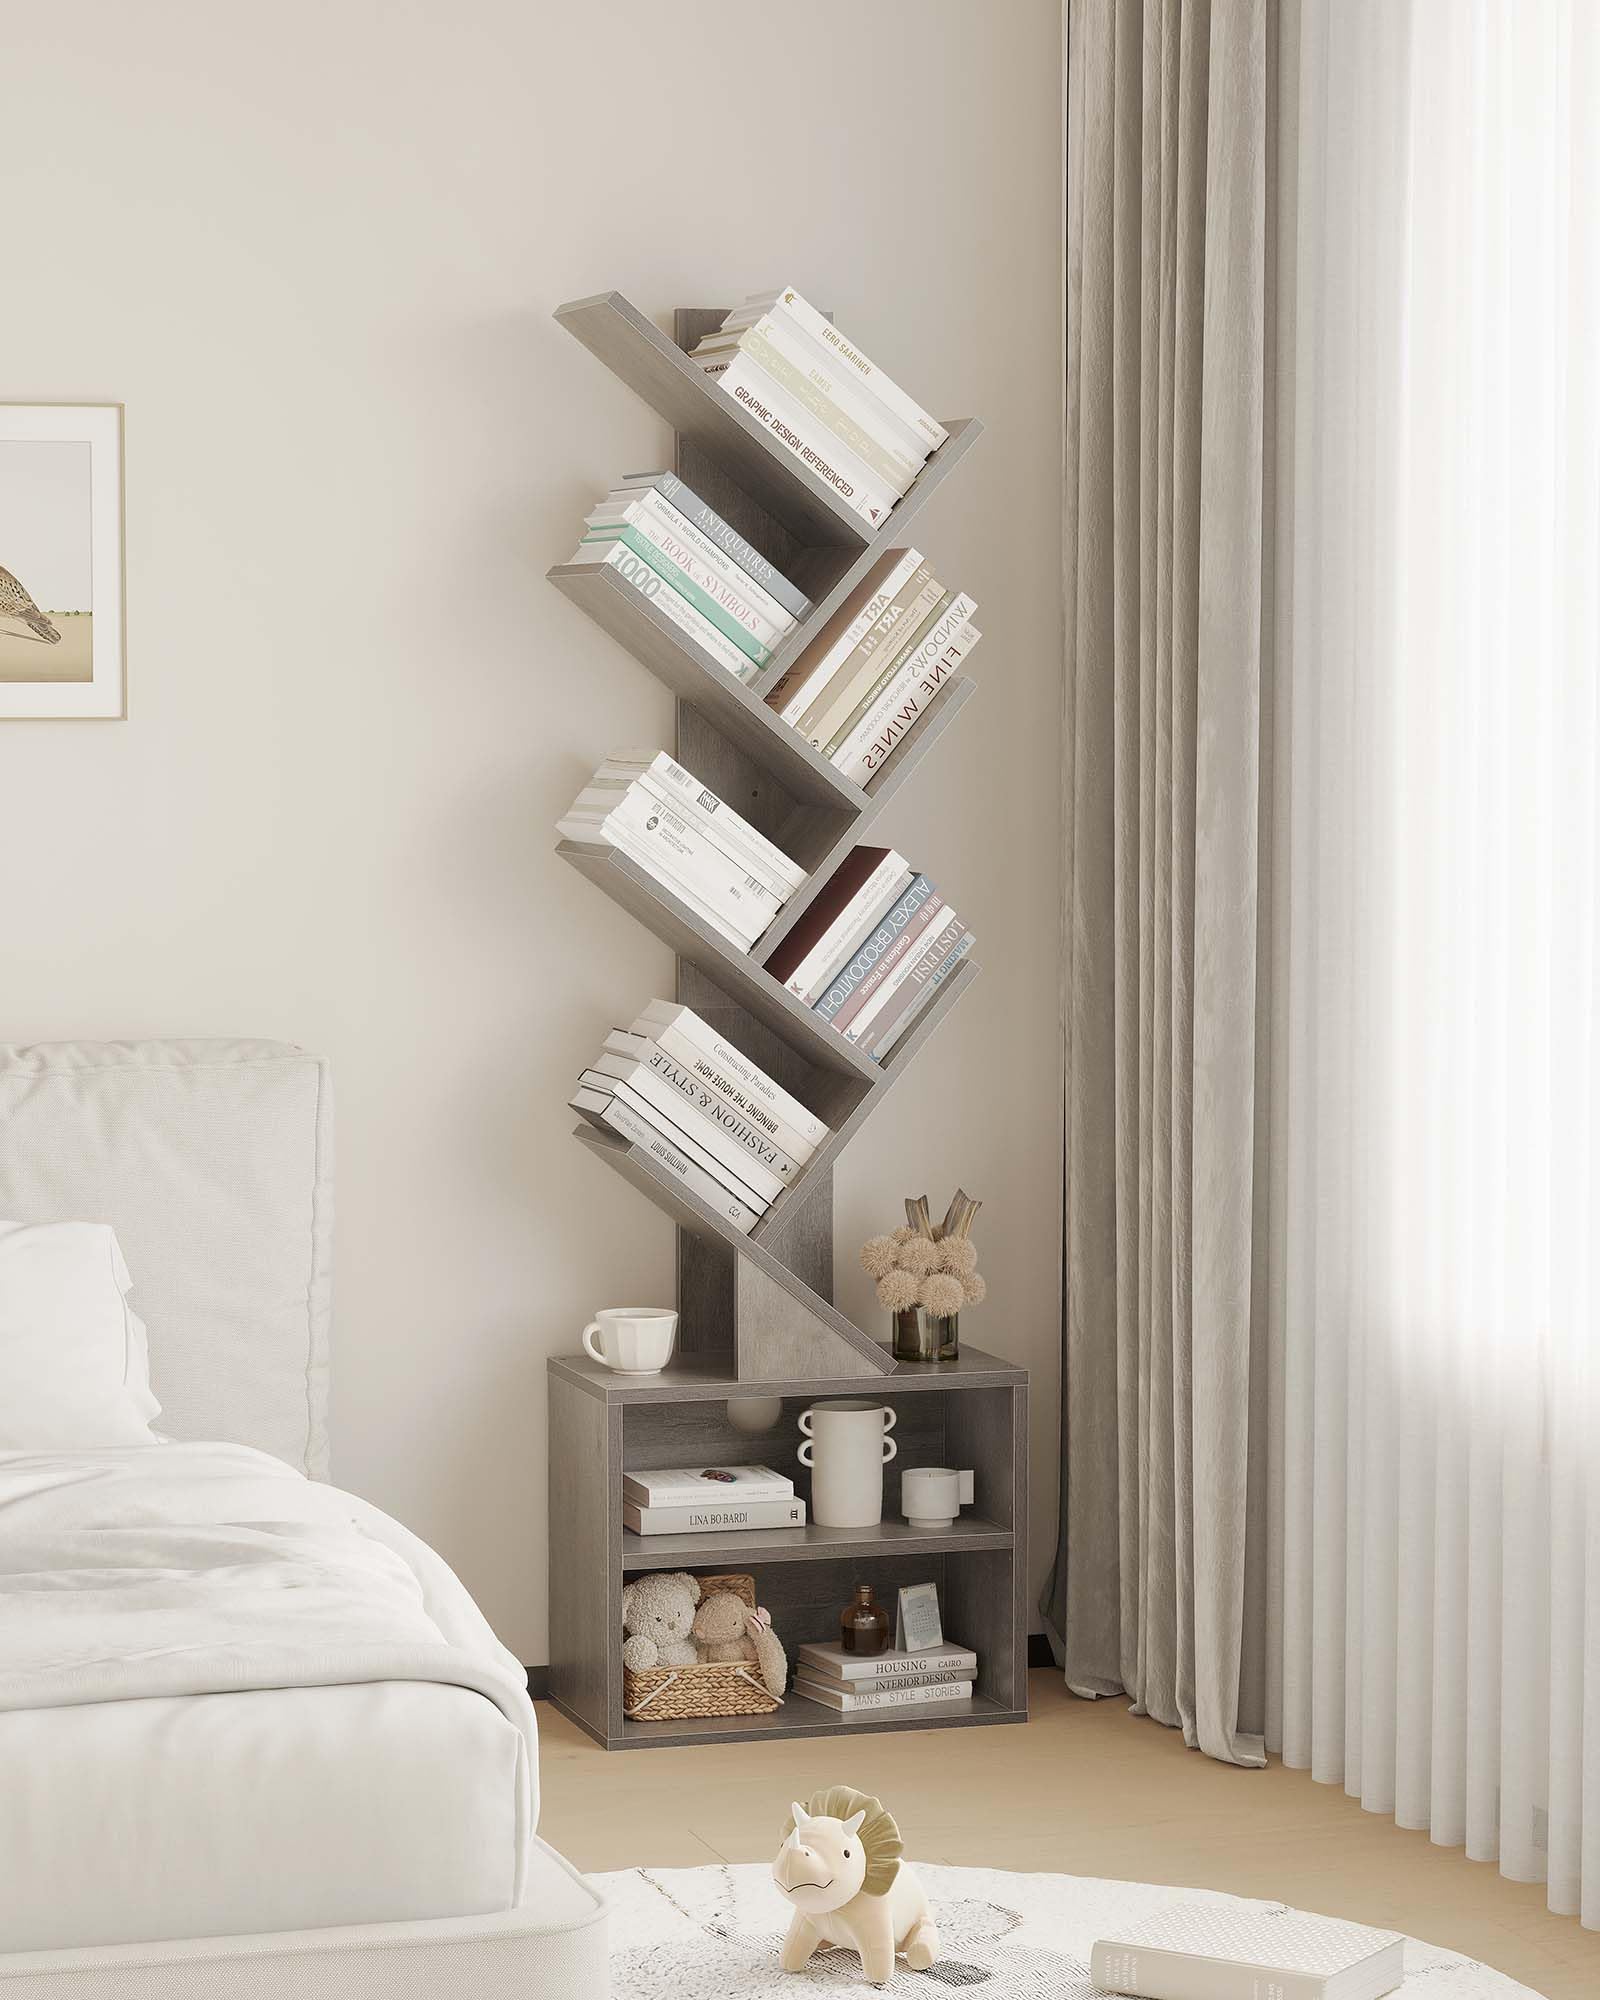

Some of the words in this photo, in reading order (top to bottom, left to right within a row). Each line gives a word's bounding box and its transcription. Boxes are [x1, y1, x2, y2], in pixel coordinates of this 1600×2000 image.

[821, 327, 841, 348] EERO
[838, 342, 872, 376] SAARINEN
[734, 386, 773, 423] GRAPHIC
[770, 418, 804, 451] DESIGN
[800, 446, 855, 498] REFERENCED
[654, 499, 680, 526] FORMULA
[680, 525, 702, 545] WORLD
[698, 540, 730, 571] CHAMPIONS
[697, 507, 775, 580] ANTIQUAIRES
[611, 550, 662, 599] 1000
[660, 536, 695, 574] BOOK
[702, 575, 760, 630] SYMBOLS
[889, 878, 930, 933] ALEXEY
[887, 935, 911, 967] Gardens
[933, 919, 966, 957] LOST
[941, 938, 969, 973] MAKING
[820, 929, 893, 1016] BRODOVITCH
[859, 970, 882, 995] France
[911, 953, 939, 985] FISH
[649, 1052, 699, 1098] STYLE
[693, 1058, 713, 1078] HOME
[713, 1043, 752, 1081] Constructing
[699, 1092, 713, 1107] &
[711, 1072, 735, 1095] HOUSE
[733, 1090, 748, 1107] THE
[711, 1104, 778, 1164] FASHION
[746, 1100, 779, 1134] BRINGING
[650, 1140, 670, 1161] LOUIS
[663, 1151, 689, 1175] SULLIVAN
[728, 1205, 741, 1219] CCA
[689, 1515, 709, 1526] LINA
[710, 1514, 722, 1524] BO
[724, 1512, 748, 1523] BARDI
[875, 1678, 920, 1690] INTERIOR
[922, 1671, 957, 1681] DESIGN
[876, 1660, 927, 1674] HOUSING
[938, 1660, 961, 1668] CAIRO
[889, 1690, 915, 1703] STYLE
[924, 1685, 961, 1699] STORIES
